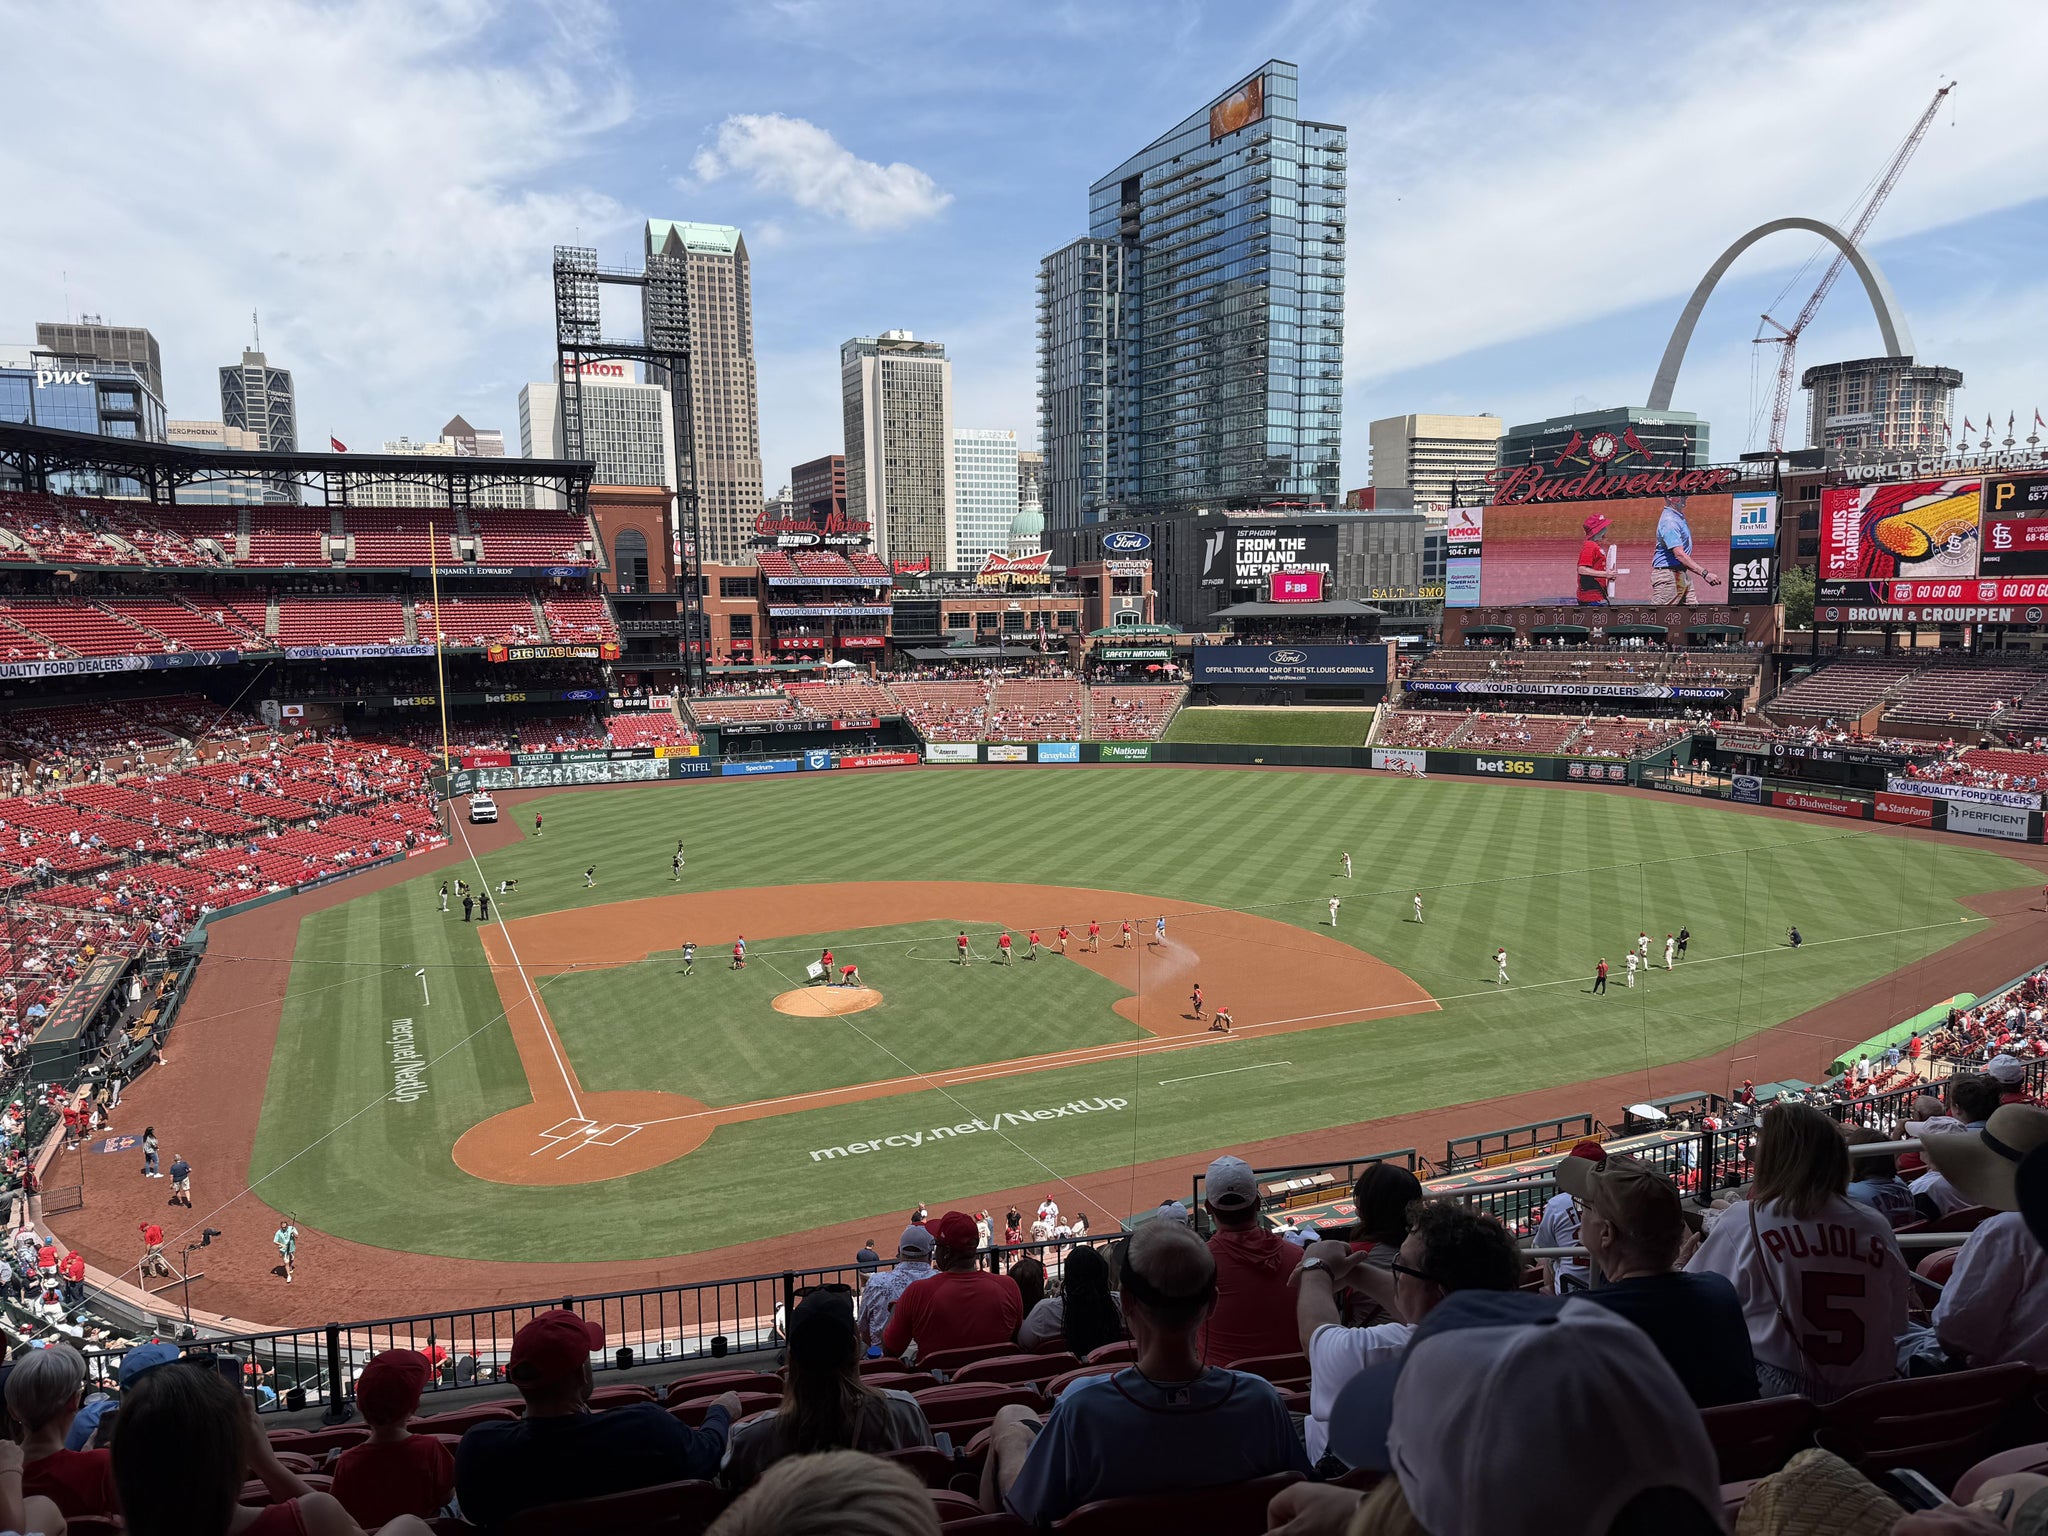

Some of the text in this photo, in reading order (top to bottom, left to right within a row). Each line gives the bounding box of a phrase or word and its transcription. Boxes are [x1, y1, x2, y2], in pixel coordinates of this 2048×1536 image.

[35, 370, 91, 388] pwc
[1845, 451, 2042, 480] WORLD CHAMPIONS
[1485, 461, 1733, 505] Budweiser
[755, 511, 872, 535] Cardinals Nation
[1846, 498, 1860, 560] CARDINALS
[1449, 528, 1481, 537] KMOX
[777, 535, 812, 544] HOFFMANN
[1113, 534, 1142, 548] Ford
[1236, 537, 1306, 551] FROM THE
[1831, 510, 1848, 569] ST. LOUIS
[1236, 551, 1296, 564] LOU AND
[1106, 560, 1151, 569] Community
[1732, 558, 1769, 580] stl
[976, 574, 1050, 585] BREW HOUSE
[1372, 588, 1405, 598] SALT
[1821, 588, 1841, 597] Mercy
[1896, 590, 1909, 598] 66
[1917, 585, 1961, 598] GO GO GO
[1981, 590, 1994, 598] 66
[2003, 584, 2018, 597] GO
[2020, 583, 2035, 597] GO
[1534, 613, 1546, 625] 10
[1553, 613, 1565, 625] 14
[1573, 613, 1584, 625] 17
[1592, 613, 1608, 625] 20
[1617, 613, 1634, 625] 23
[1640, 613, 1657, 625] 24
[1665, 613, 1681, 625] 42
[1690, 613, 1707, 625] 45
[1712, 613, 1730, 625] 85
[1848, 607, 2011, 622] BROWN & CROUPPEN
[321, 648, 359, 656] QUALITY
[362, 648, 386, 656] FORD
[388, 647, 427, 655] DEALERS
[509, 648, 534, 660] BIG
[535, 647, 565, 659] MAC
[1105, 650, 1168, 658] SAFETY NATIONAL
[1275, 650, 1300, 662] Ford
[0, 659, 124, 678] UALITY FORD DEALERS
[1205, 666, 1374, 674] OFFICIAL TRUCK AND CAR OF THE ST. LOUIS CARDINALS
[1415, 682, 1451, 691] FORD.COM
[1486, 684, 1639, 696] YOUR QUALITY FORD DEALERS
[486, 693, 526, 703] bet365
[1679, 689, 1724, 698] FORD.COM
[394, 697, 436, 706] bet365
[1720, 739, 1765, 750] Schnucks
[1113, 746, 1148, 756] National
[1788, 748, 1805, 757] 1:02
[680, 763, 710, 773] STIFEL
[867, 758, 905, 766] Budweiser
[1476, 758, 1534, 774] bet365
[1654, 782, 1702, 795] BUSCH STADIUM
[1737, 778, 1755, 788] Ford
[1895, 782, 2032, 806] YOUR QUALITY FORD DEALERS
[1800, 798, 1848, 813] Budweiser
[1962, 809, 2026, 826] PERFICIENT
[386, 1018, 428, 1103] mercy.net/NextUp
[809, 1096, 1128, 1162] mercy.net/NextUp
[1762, 1224, 1887, 1269] PUJOLS
[1801, 1271, 1865, 1367] 5
